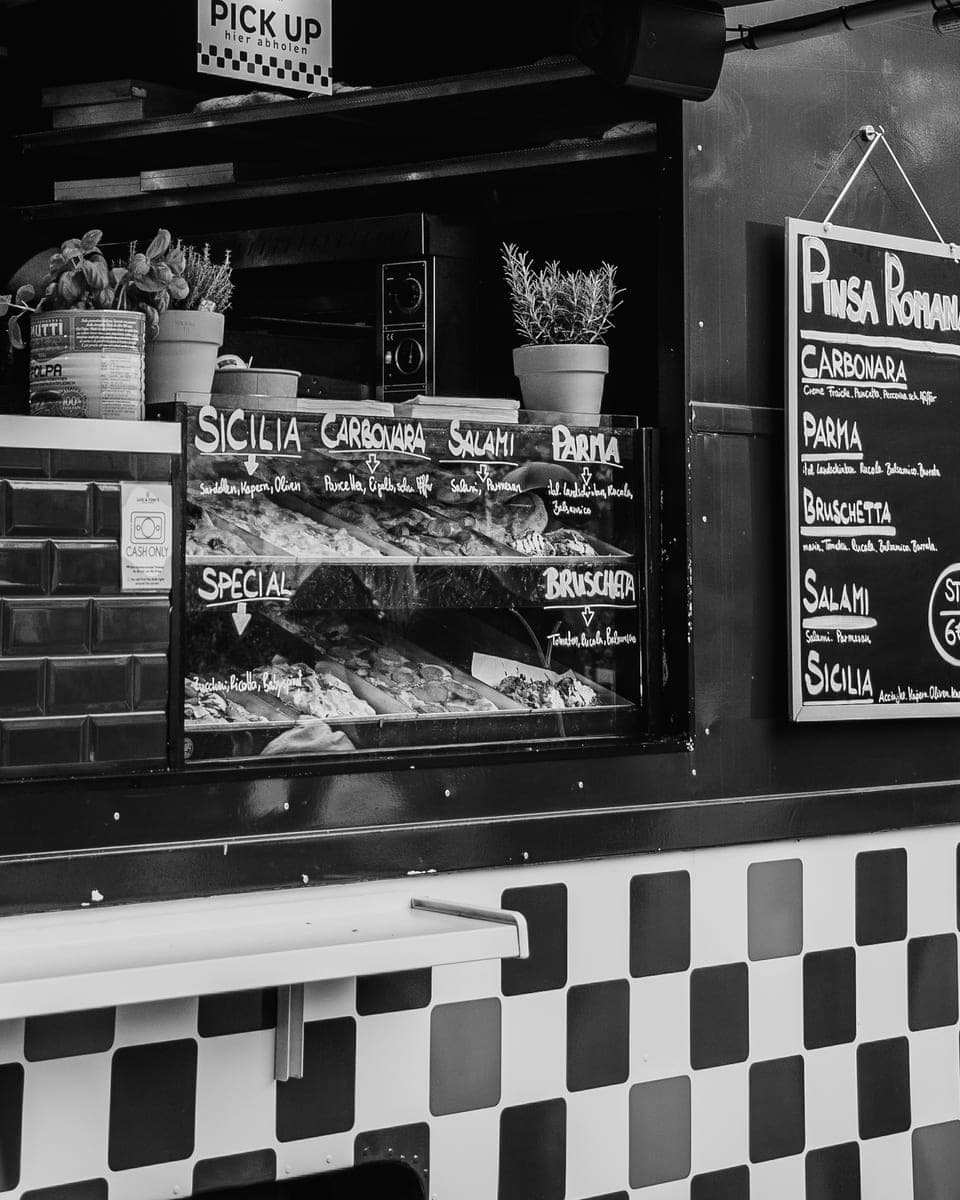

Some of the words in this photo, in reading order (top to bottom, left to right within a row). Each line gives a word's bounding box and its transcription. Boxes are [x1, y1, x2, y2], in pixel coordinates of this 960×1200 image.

[211, 0, 276, 38] PICK
[285, 14, 322, 45] UP
[225, 30, 251, 43] hier
[257, 38, 308, 55] abholen
[802, 236, 879, 325] PINSA
[885, 252, 960, 331] ROMAN
[801, 344, 908, 382] CARBONARA
[195, 405, 301, 452] SICILIA
[321, 413, 426, 453] CARBONARA
[448, 419, 514, 458] SALAMI
[552, 425, 621, 463] PARMA
[803, 411, 862, 451] PARMA
[275, 476, 301, 492] Oliven
[803, 487, 891, 524] BRUSCHETTA
[126, 546, 147, 557] CASH
[149, 546, 168, 557] ONLY
[198, 567, 293, 600] SPECIAL
[803, 568, 869, 616] SALAMI
[804, 650, 873, 696] SICILIA
